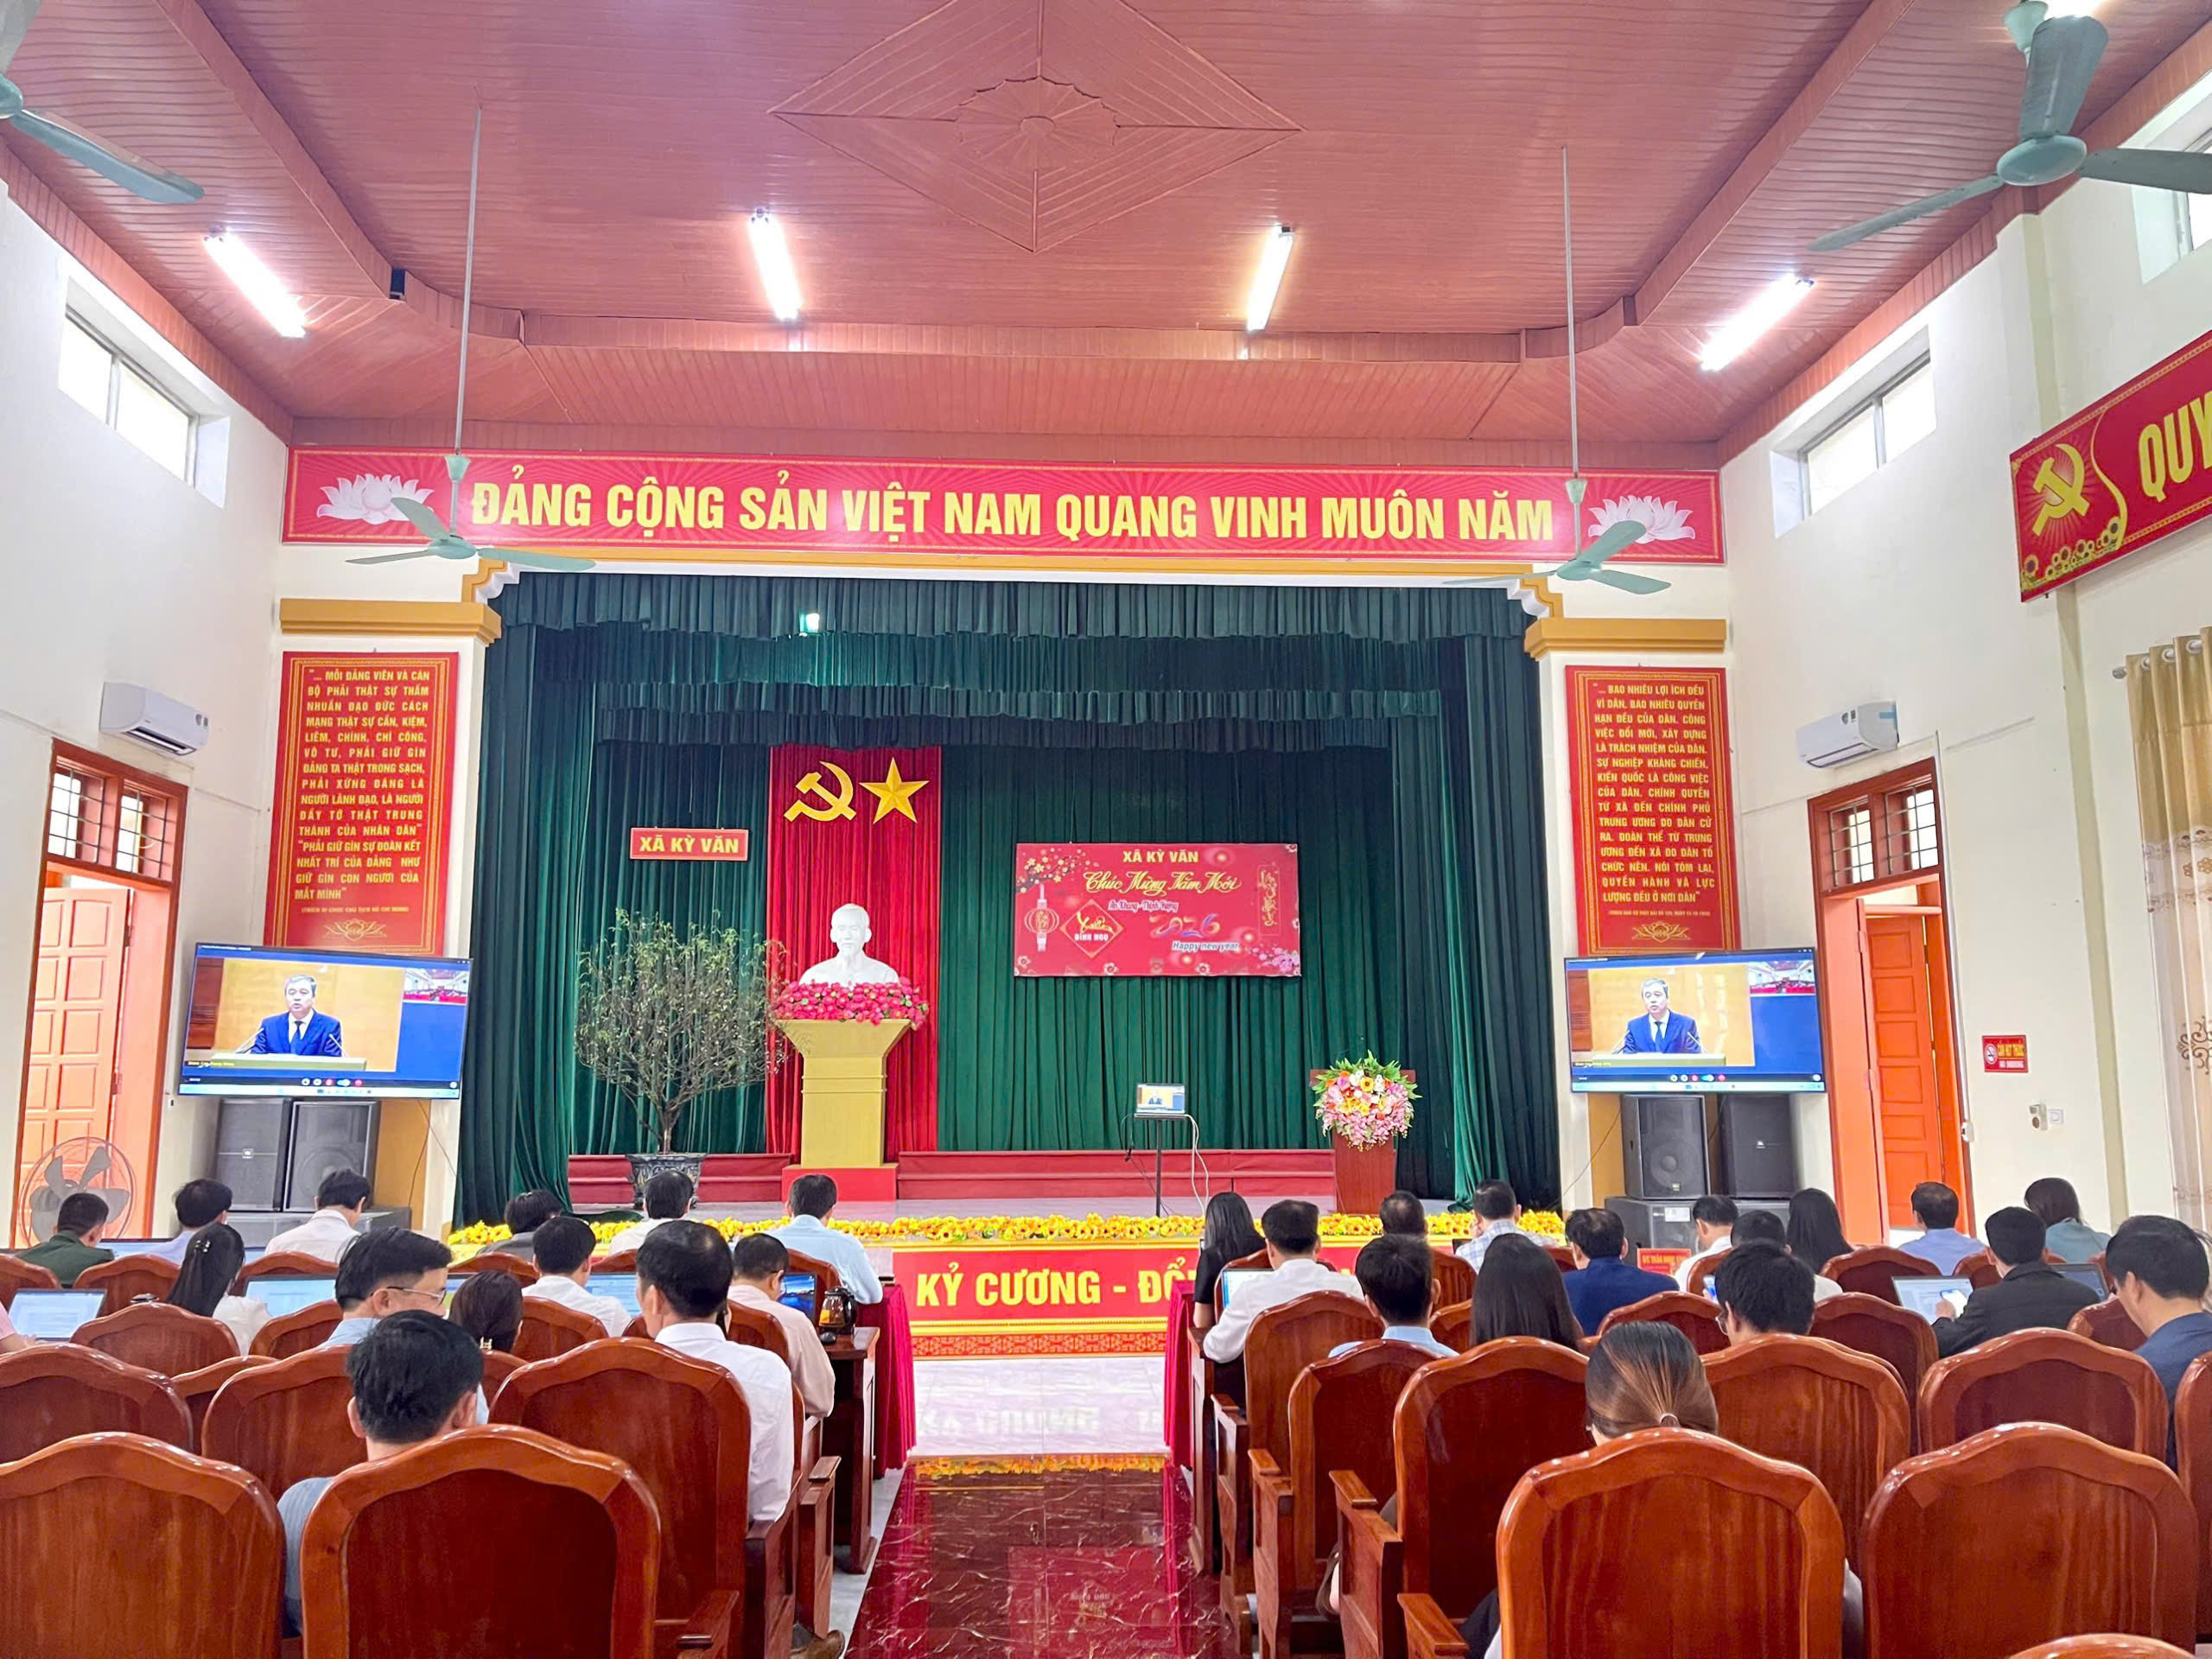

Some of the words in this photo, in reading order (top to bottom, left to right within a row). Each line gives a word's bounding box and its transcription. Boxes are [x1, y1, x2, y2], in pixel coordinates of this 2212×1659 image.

[472, 465, 591, 526] ĐẢNG
[607, 476, 724, 537] CỘNG
[740, 471, 829, 531] SẢN
[843, 481, 931, 542] VIỆT
[944, 492, 1040, 536] NAM
[1056, 493, 1197, 541] QUANG
[1210, 495, 1307, 538] VINH
[1321, 489, 1445, 540] MUÔN
[1459, 490, 1554, 541] NĂM
[639, 835, 665, 851] XÃ
[671, 835, 696, 853] KỲ
[700, 836, 739, 853] VĂN
[1122, 849, 1142, 862] XÃ
[1169, 849, 1198, 862] VĂN
[1149, 913, 1221, 938] 2026
[1173, 941, 1199, 953] Happy
[916, 1262, 964, 1306] KỶ
[976, 1268, 1101, 1306] CƯƠNG
[1138, 1257, 1197, 1303] ĐỔ
